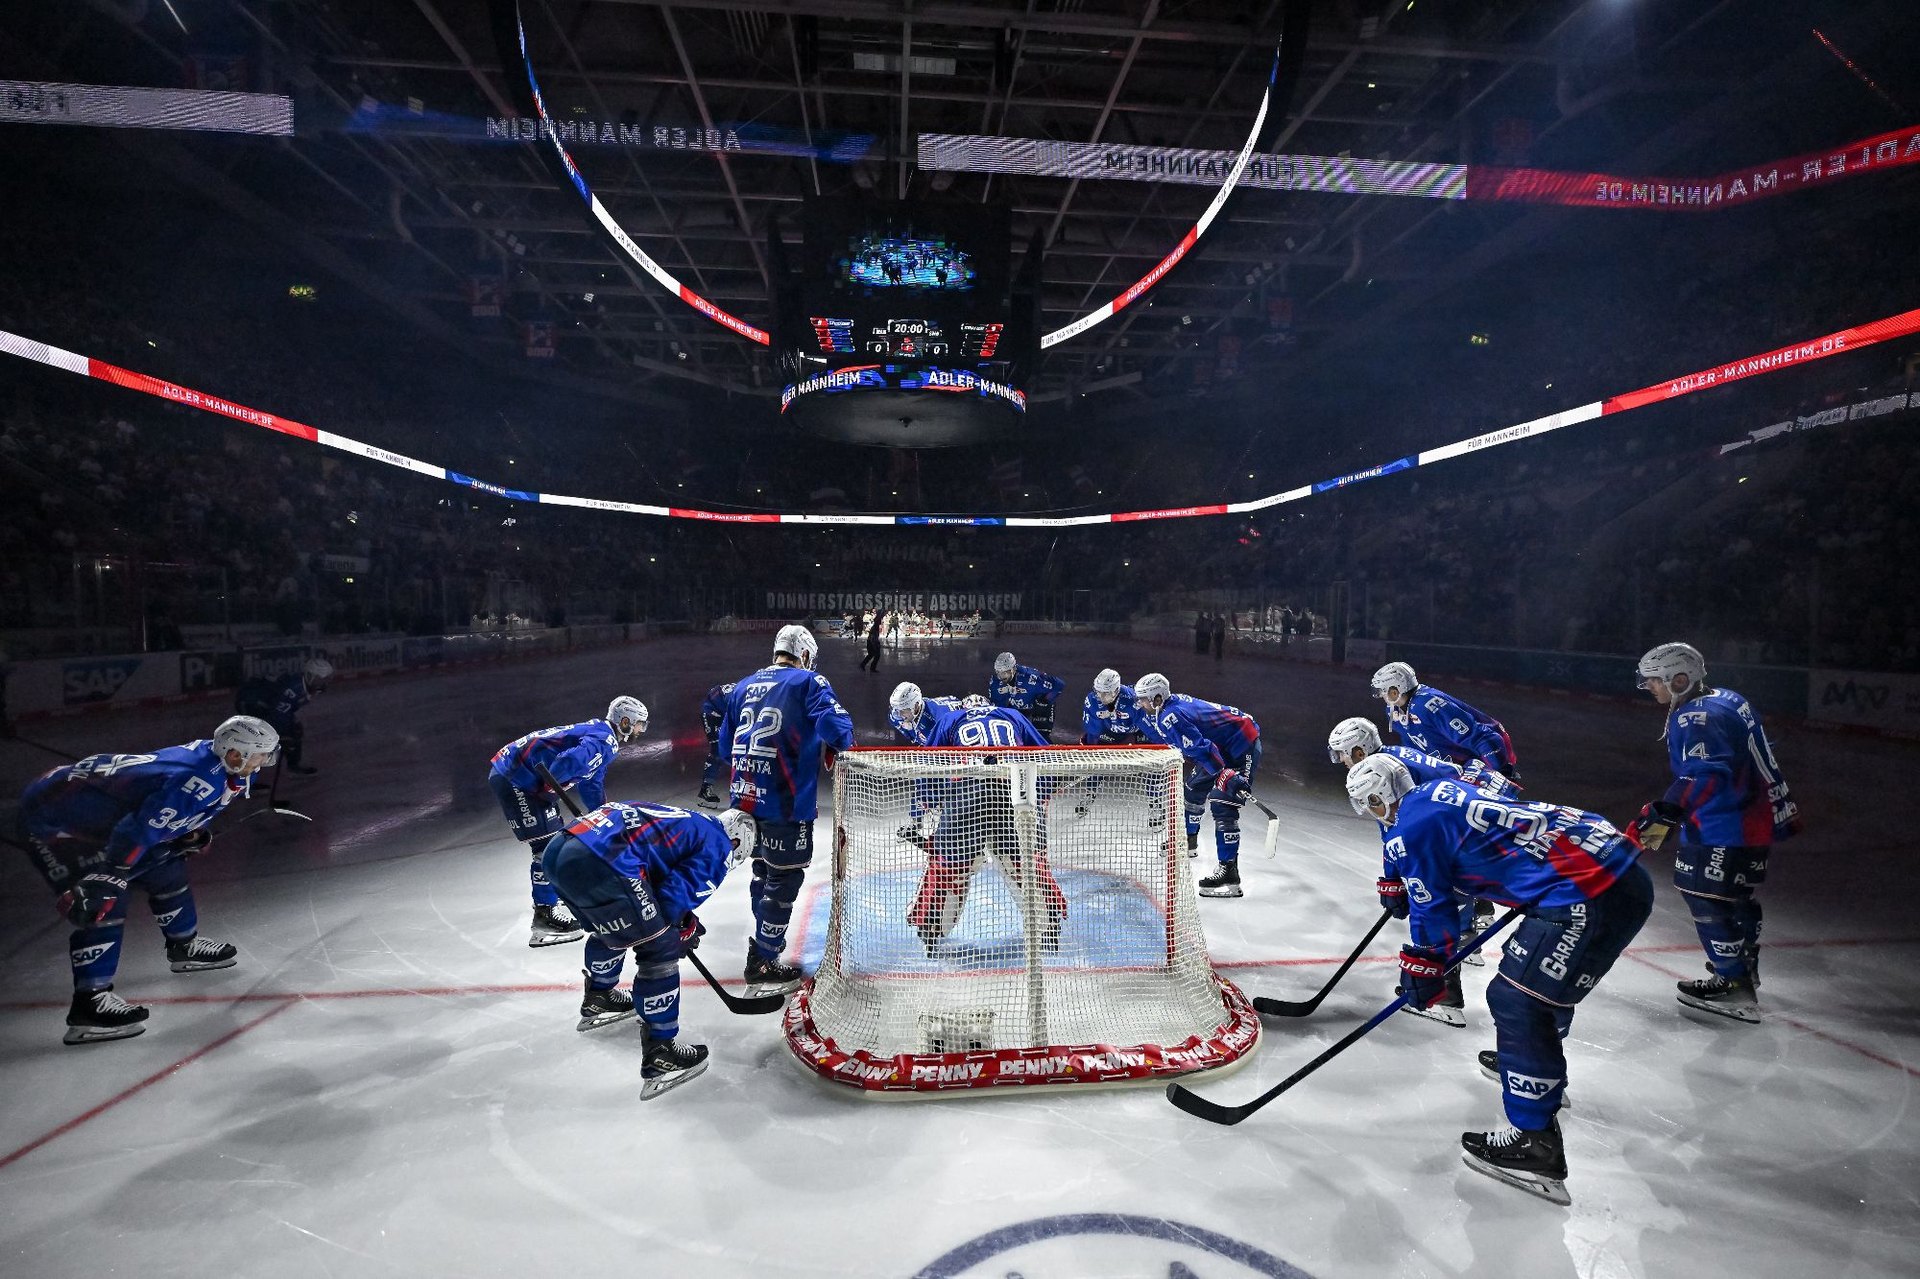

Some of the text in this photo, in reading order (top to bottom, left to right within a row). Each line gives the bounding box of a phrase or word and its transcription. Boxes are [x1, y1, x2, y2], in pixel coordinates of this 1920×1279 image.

[894, 322, 924, 335] 20:00
[875, 343, 882, 354] 0
[933, 345, 940, 356] 0
[1670, 335, 1847, 395] ADLER-MANNHEIM.DE
[798, 371, 861, 396] MANNHEIM
[163, 383, 274, 427] ADLER-MANNHEIM.DE
[1467, 424, 1532, 451] FÜR MANNHEIM
[744, 684, 769, 700] SAP
[731, 706, 783, 758] 22
[958, 719, 1016, 746] 90
[1449, 717, 1470, 735] 9
[763, 924, 785, 936] SAP
[72, 948, 105, 963] SAP
[1714, 943, 1740, 954] SAP
[592, 958, 620, 973] SAP
[644, 995, 675, 1012] SAP
[1000, 1056, 1069, 1075] PENNY
[1082, 1052, 1146, 1073] PENNY
[911, 1063, 984, 1081] PENNY
[1509, 1076, 1550, 1096] SAP
